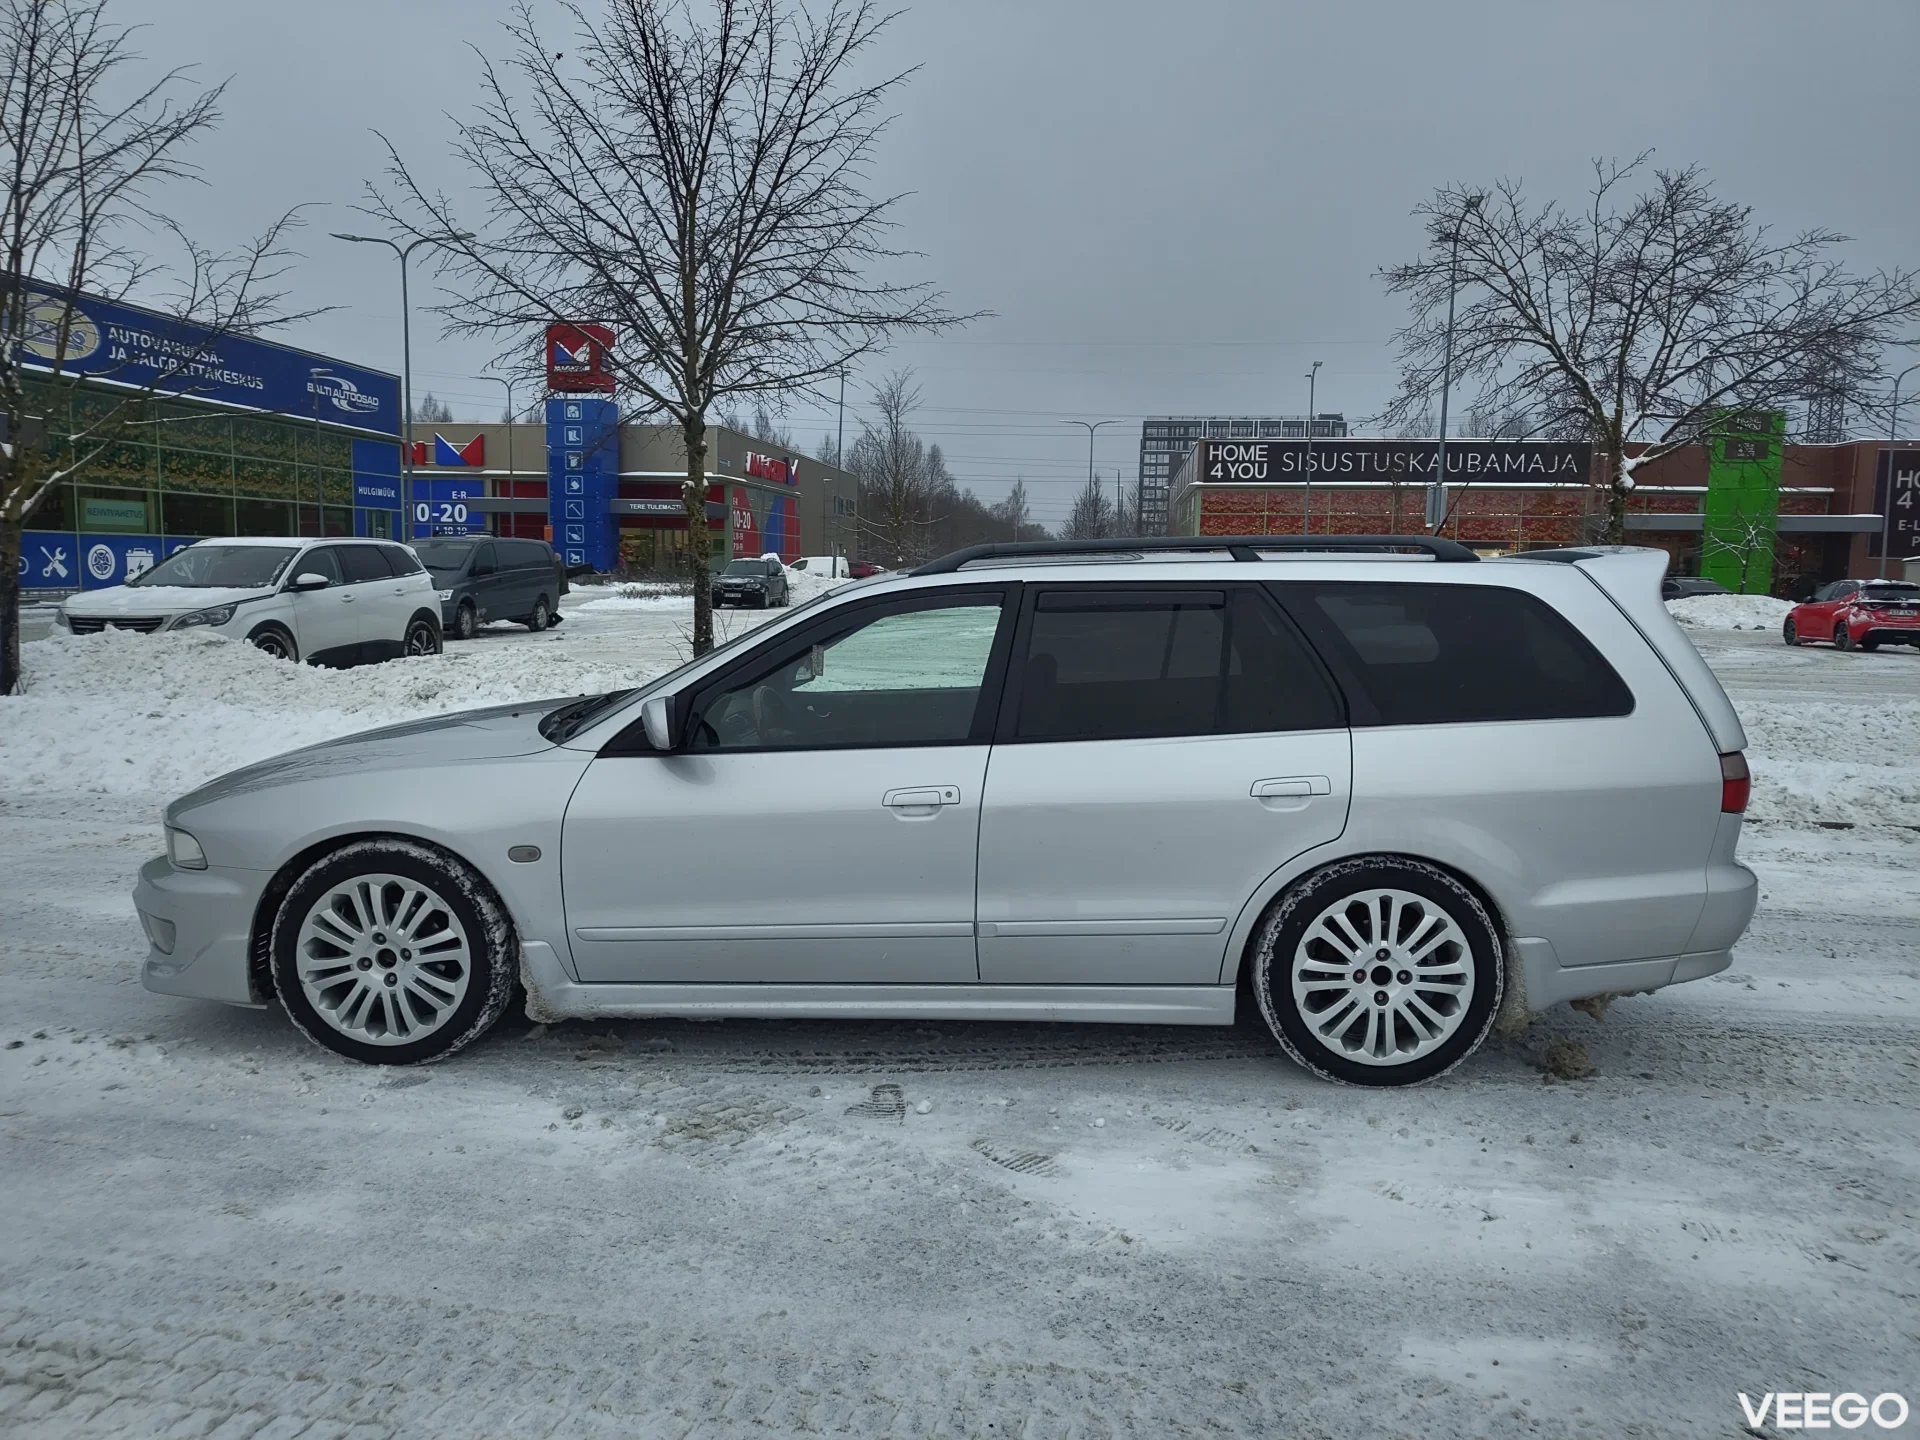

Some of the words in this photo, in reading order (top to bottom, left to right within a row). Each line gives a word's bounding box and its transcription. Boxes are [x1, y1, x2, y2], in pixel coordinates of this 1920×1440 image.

[109, 346, 127, 360] JA
[332, 388, 379, 406] AUTOOSAD
[1209, 444, 1269, 461] HOME
[1281, 452, 1578, 473] SISUSTUSKAUBAMAJA
[1210, 463, 1224, 479] 4
[1227, 463, 1268, 479] YOU
[358, 486, 396, 498] HULGIMÜÜK
[451, 491, 467, 500] E-R
[1896, 490, 1914, 509] 4
[86, 507, 144, 519] REHVIVAHETUS
[733, 510, 751, 530] 10-20
